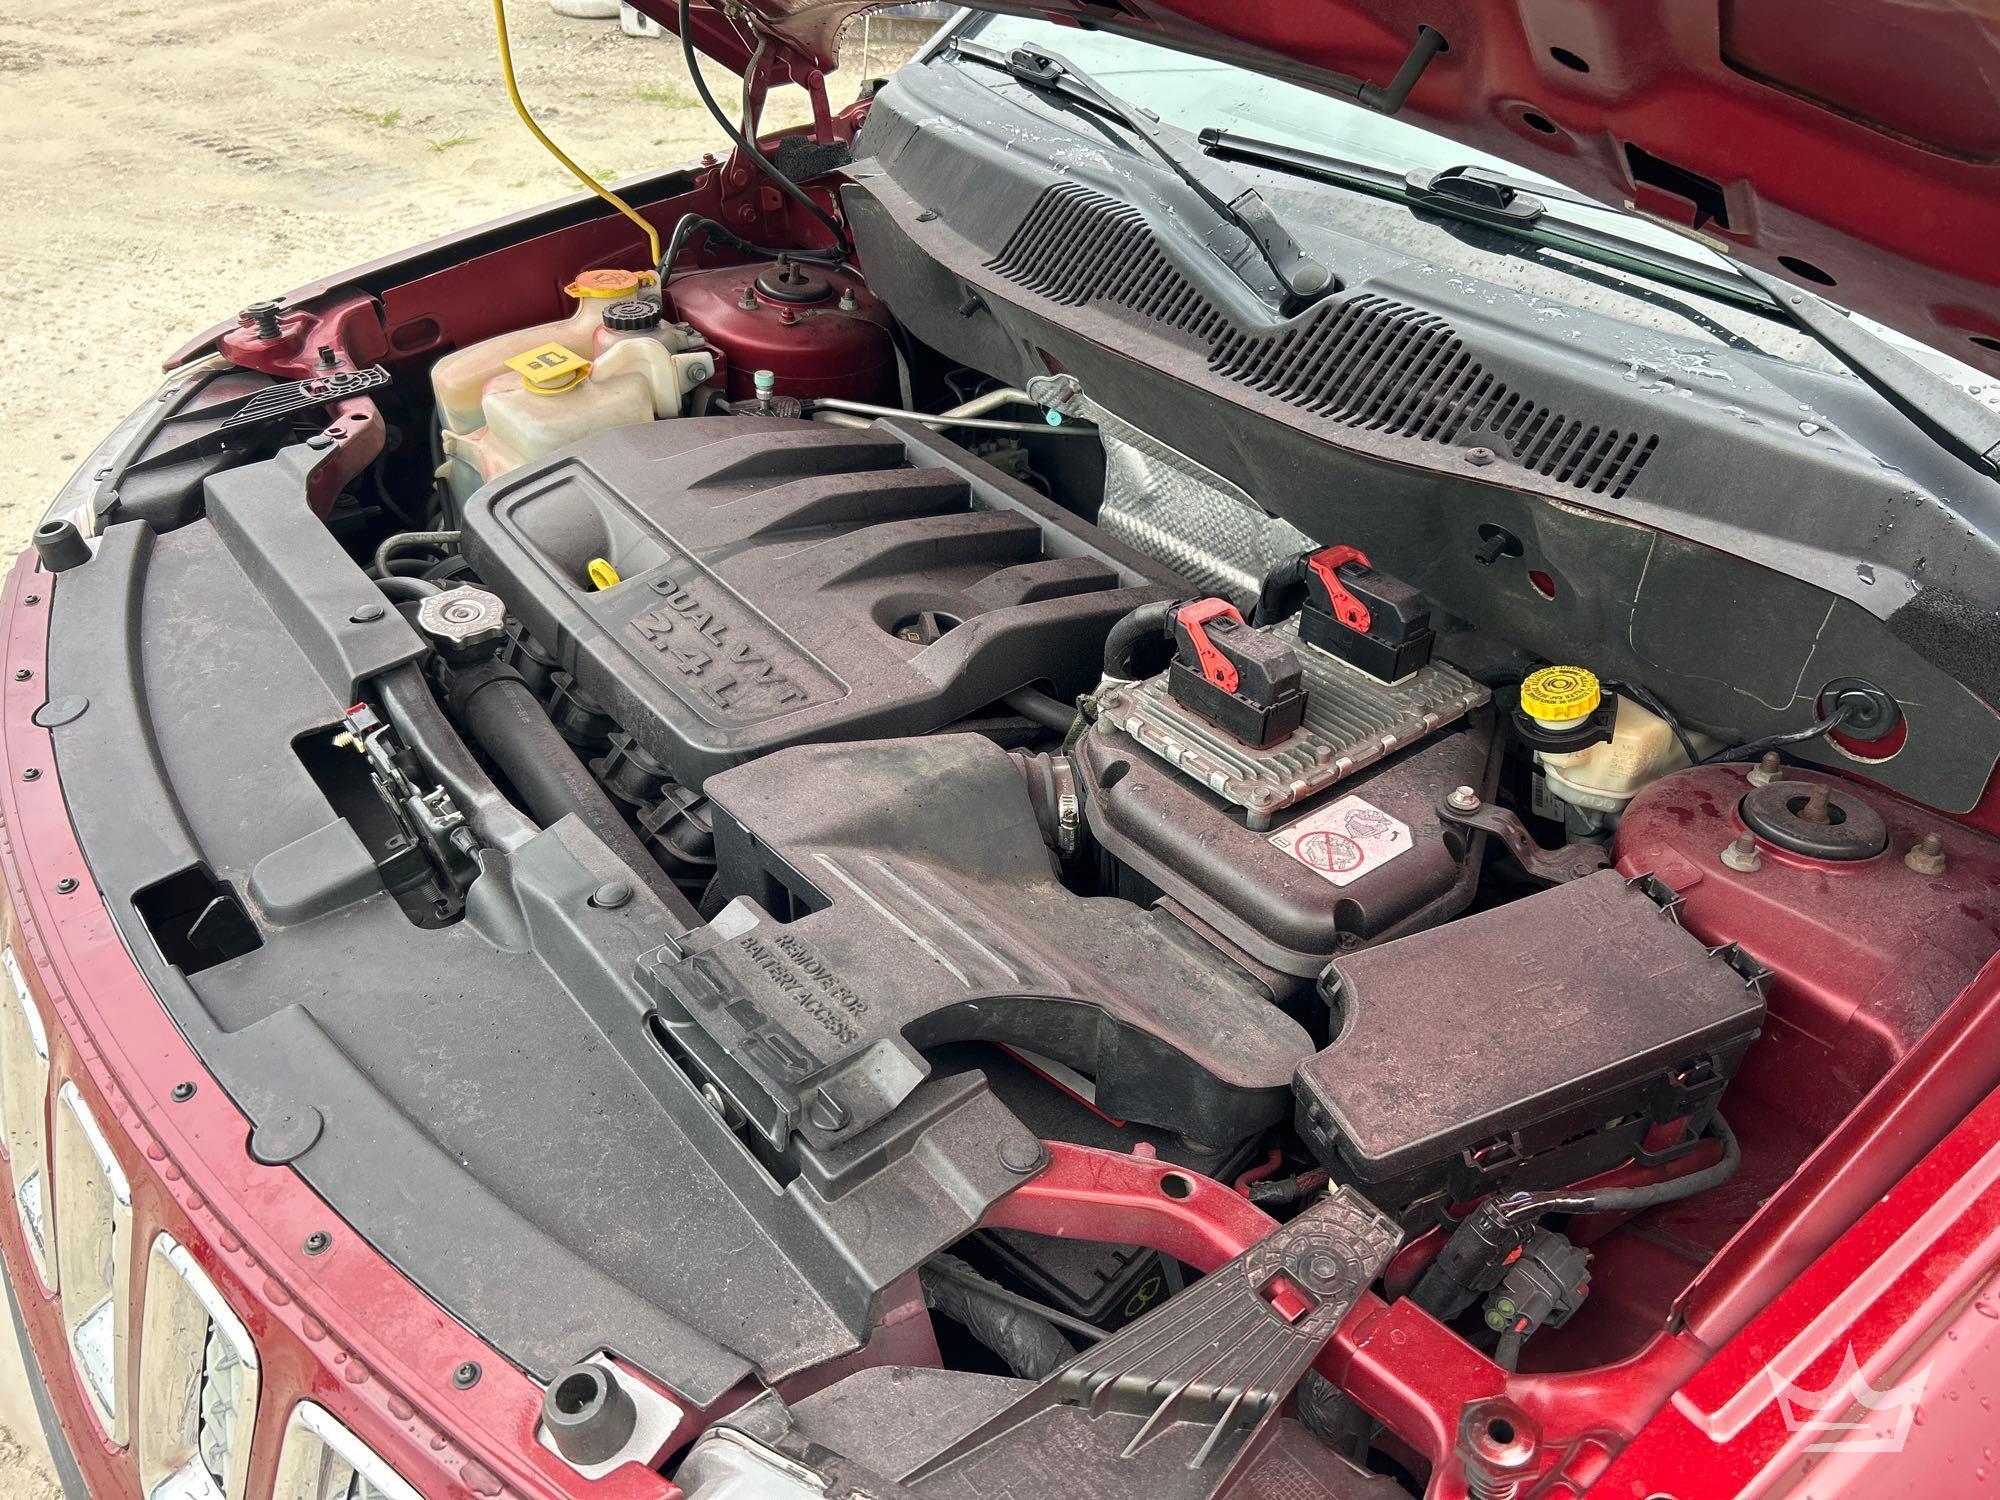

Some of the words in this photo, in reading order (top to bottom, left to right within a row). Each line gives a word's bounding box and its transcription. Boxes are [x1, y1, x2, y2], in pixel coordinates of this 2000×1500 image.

[630, 613, 713, 676] 2.4
[701, 673, 737, 709] L
[648, 575, 727, 647] DUAL
[730, 643, 807, 704] VVT
[740, 936, 805, 993] BATTERY
[794, 992, 860, 1044] ACCESS
[775, 934, 840, 991] REMOVE
[831, 986, 868, 1017] FOR
